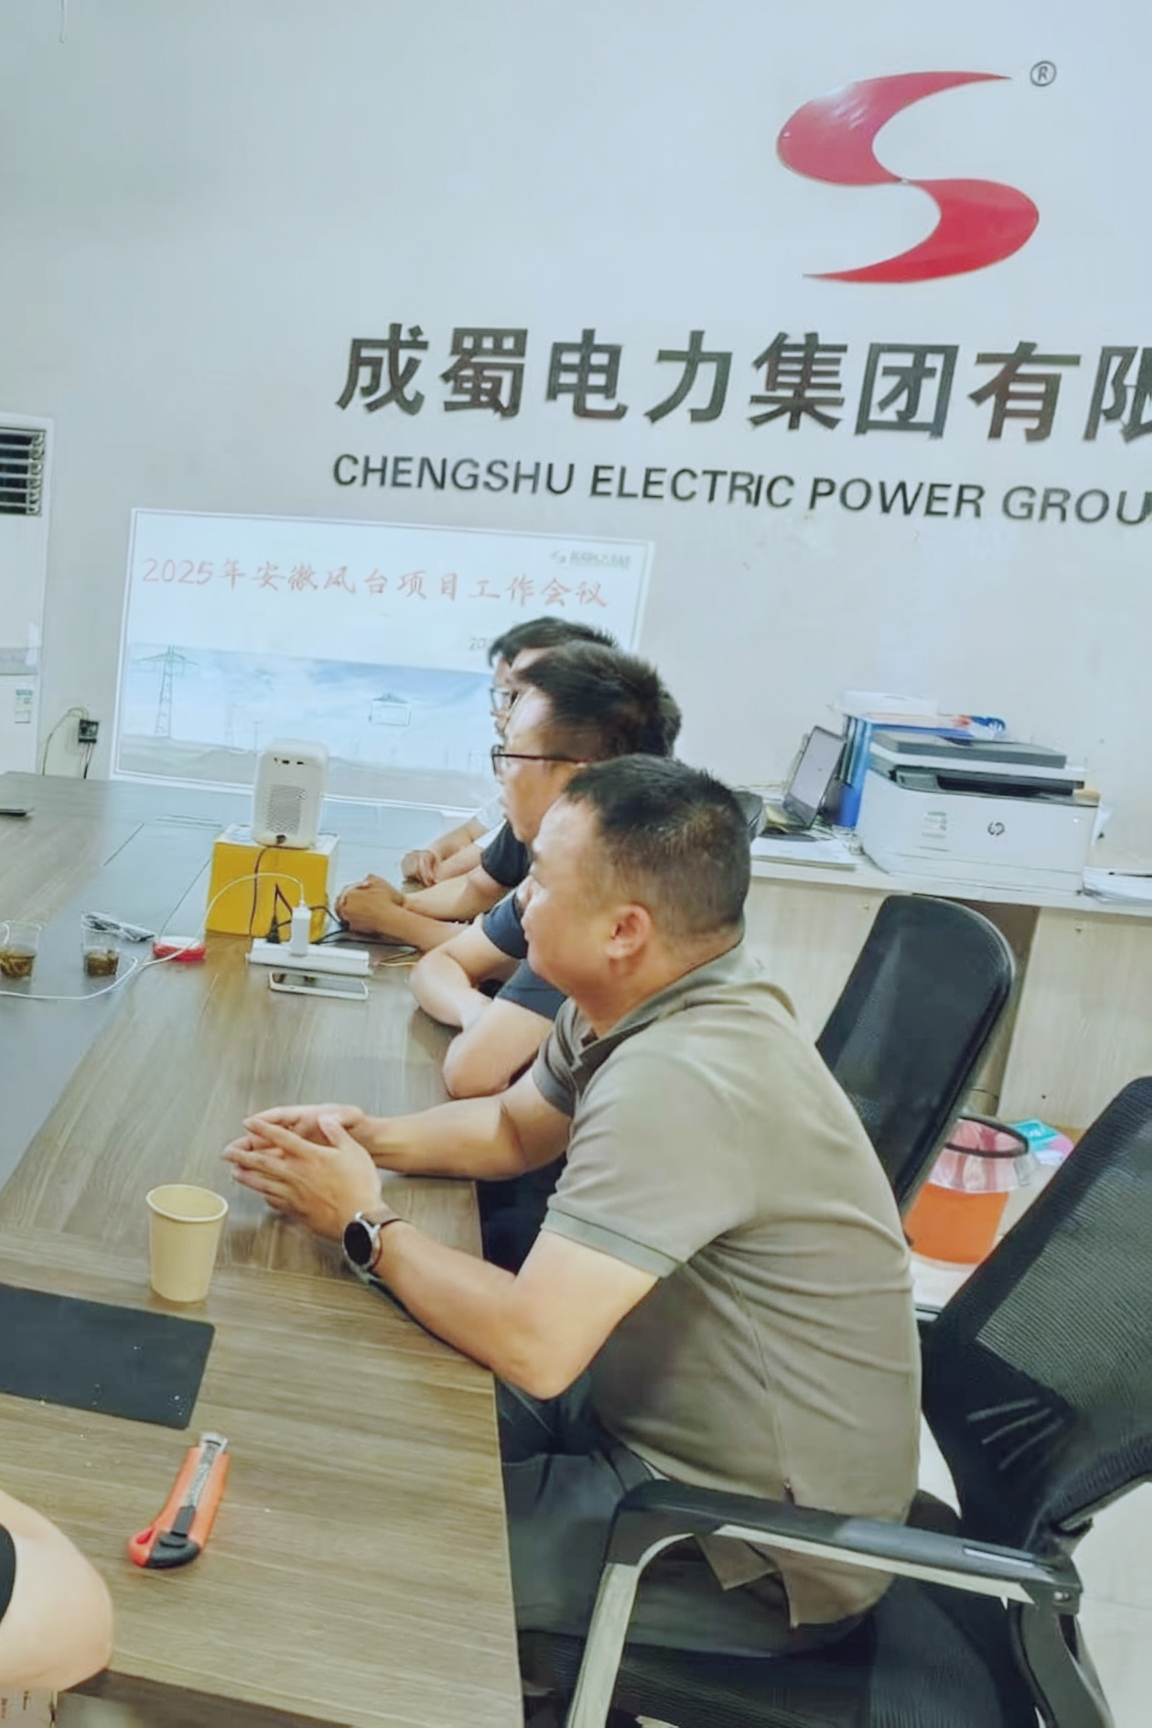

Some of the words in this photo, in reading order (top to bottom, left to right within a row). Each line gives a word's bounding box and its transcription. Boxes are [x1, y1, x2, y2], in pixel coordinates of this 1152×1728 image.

[336, 322, 1152, 444] 成蜀电力集团有限
[333, 453, 575, 496] CHENGSHU
[589, 464, 796, 509] ELECTRIC
[808, 477, 986, 520] POWER
[1001, 485, 1152, 526] GROU
